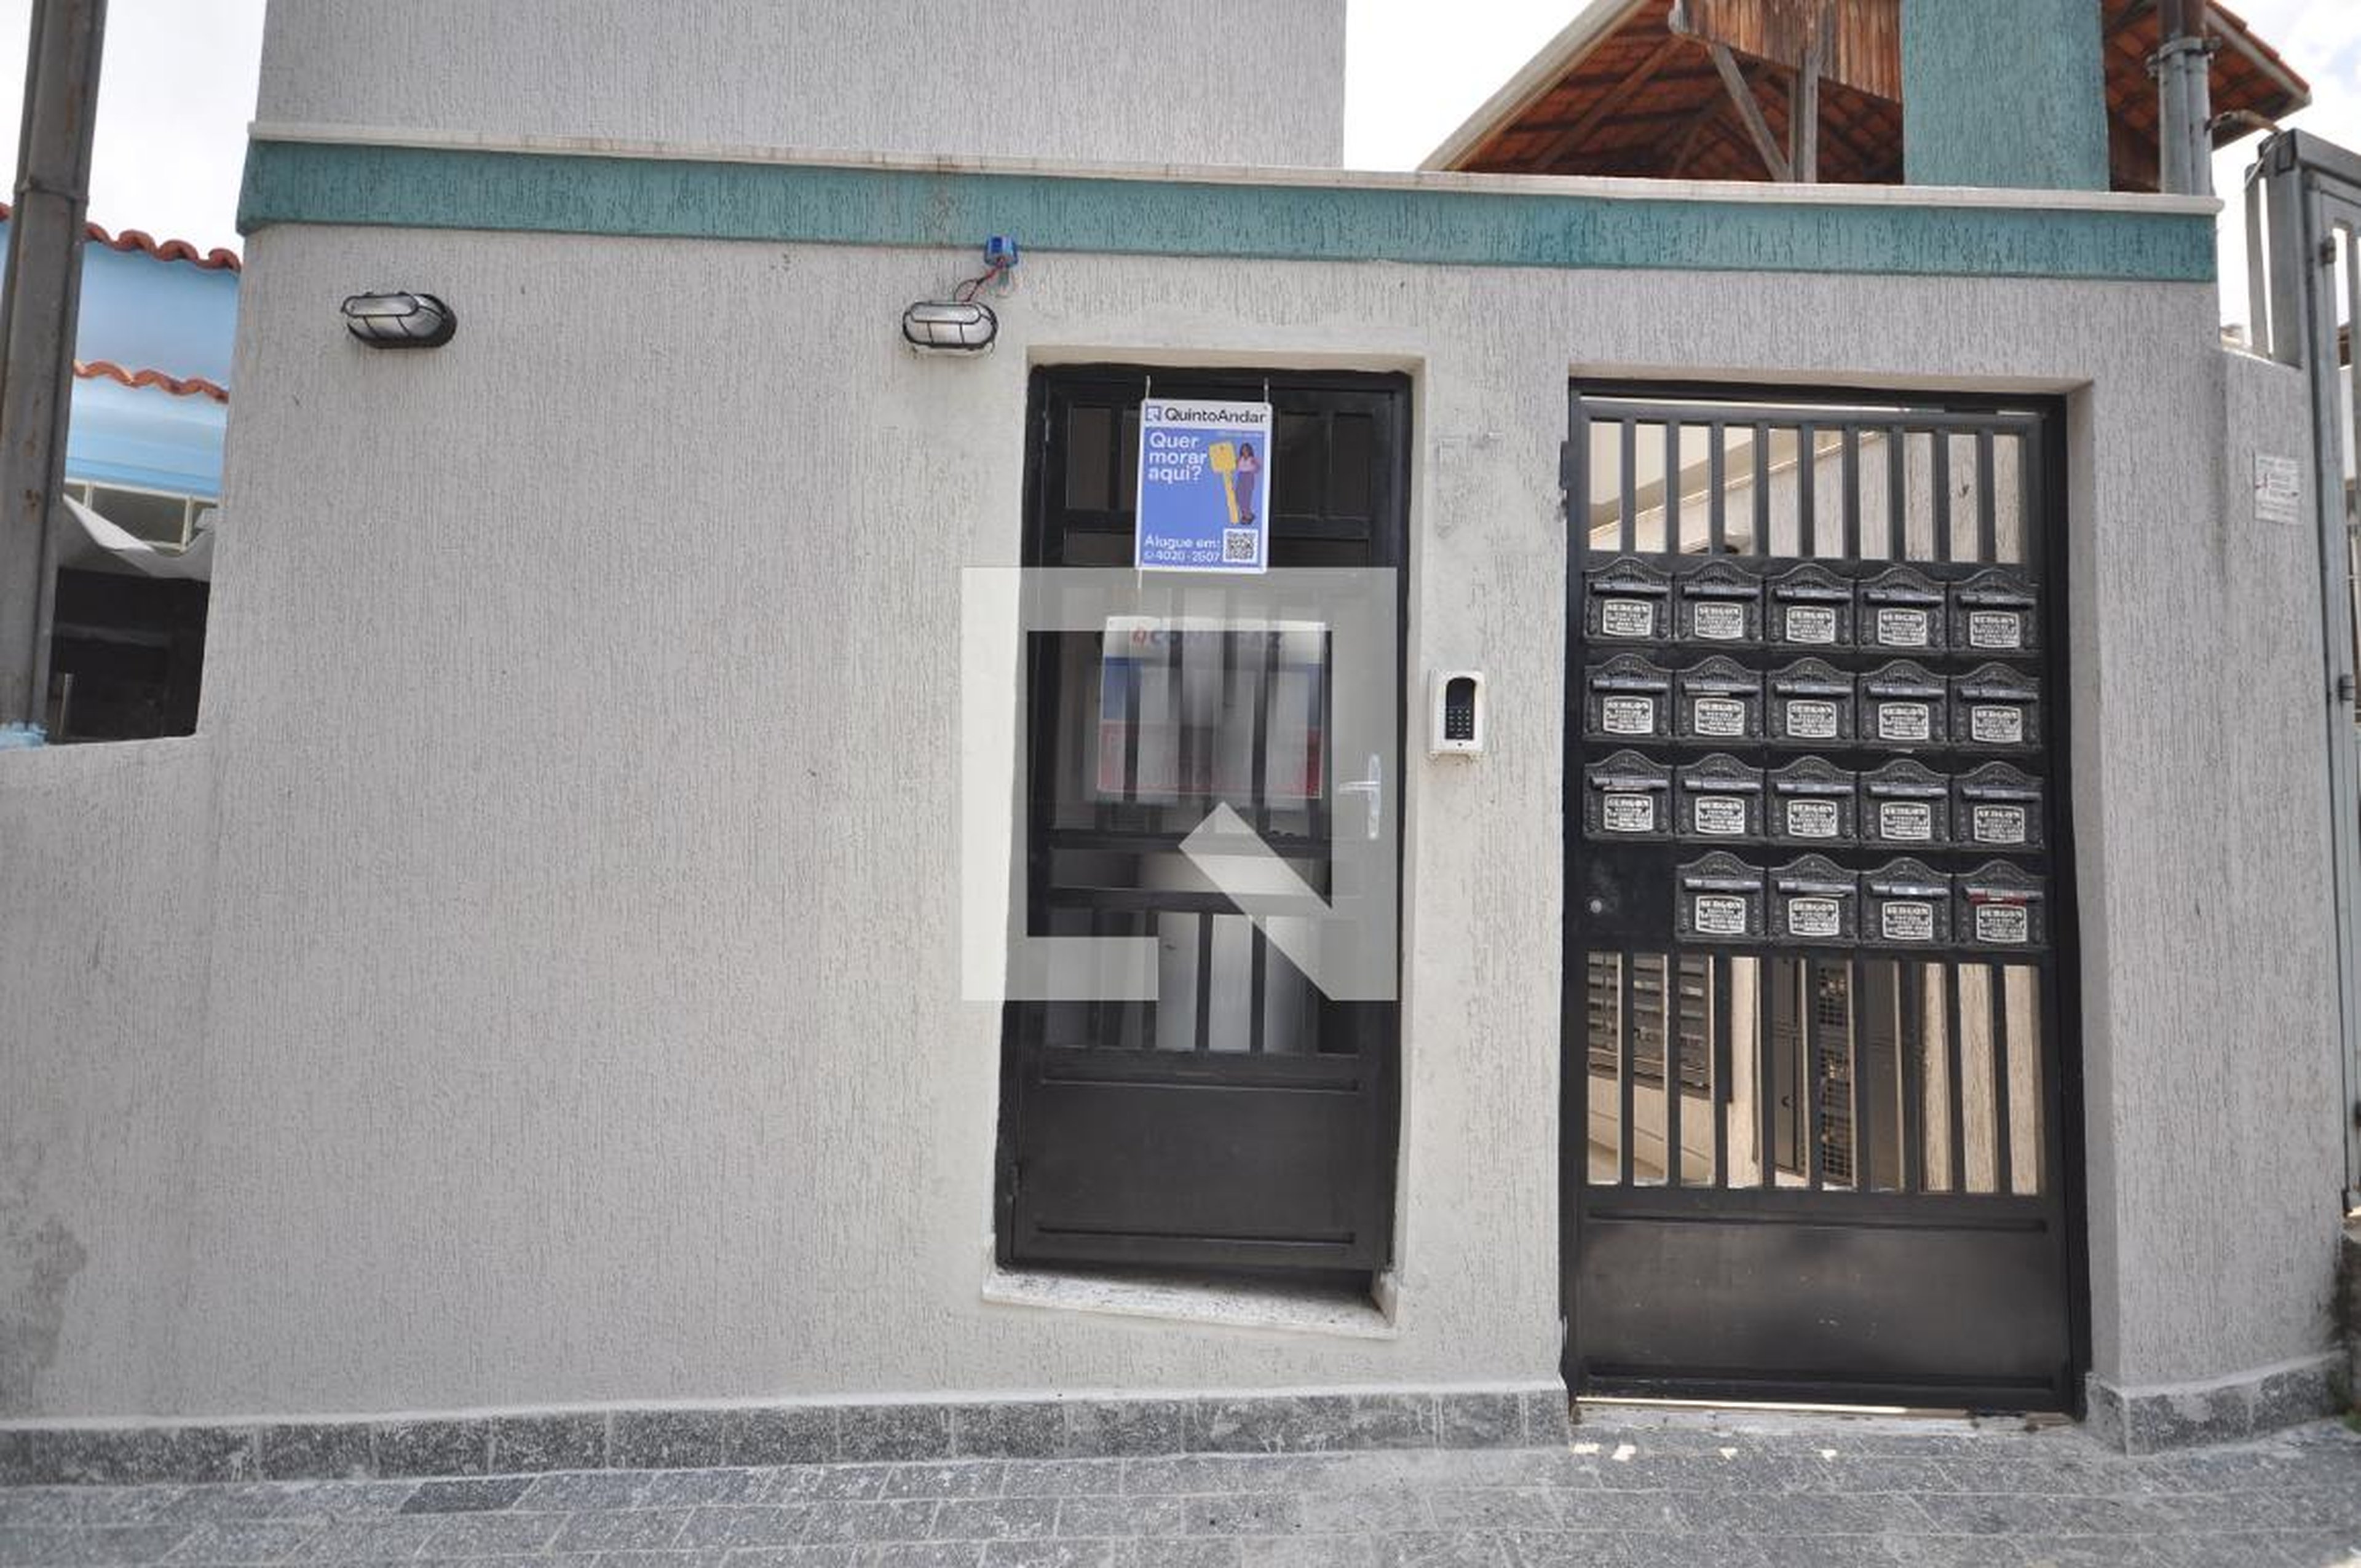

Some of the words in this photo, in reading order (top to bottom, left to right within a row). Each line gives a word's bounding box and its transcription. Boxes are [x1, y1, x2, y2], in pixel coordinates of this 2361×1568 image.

[1165, 408, 1265, 423] QuintoAndar
[1150, 431, 1198, 448] Quer
[1149, 452, 1207, 465] morar
[1148, 465, 1202, 484] aqui?
[1145, 534, 1193, 550] Alugue
